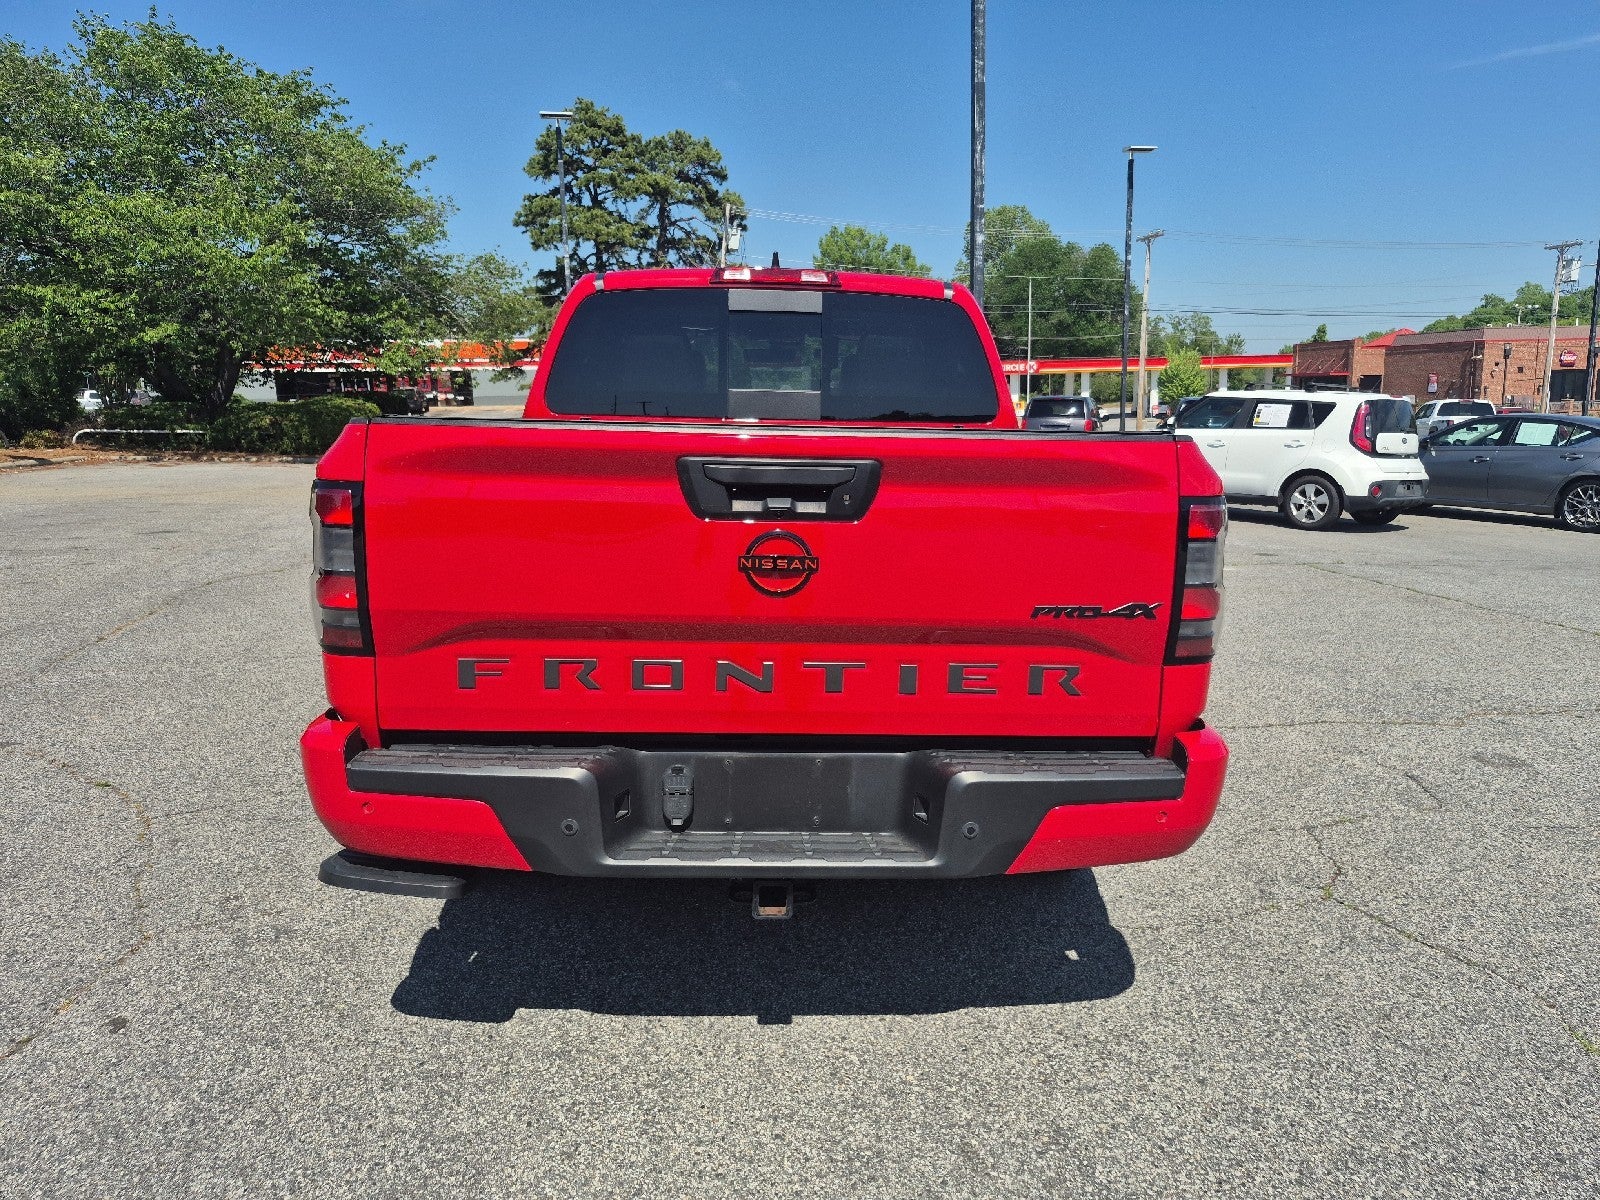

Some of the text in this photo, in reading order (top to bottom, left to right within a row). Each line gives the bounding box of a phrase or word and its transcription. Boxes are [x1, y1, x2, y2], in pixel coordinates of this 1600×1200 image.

[1001, 363, 1026, 372] IRCLE
[739, 557, 818, 570] NISSAN
[1030, 602, 1163, 620] PRO-4X
[457, 657, 1081, 697] FRONTIER
